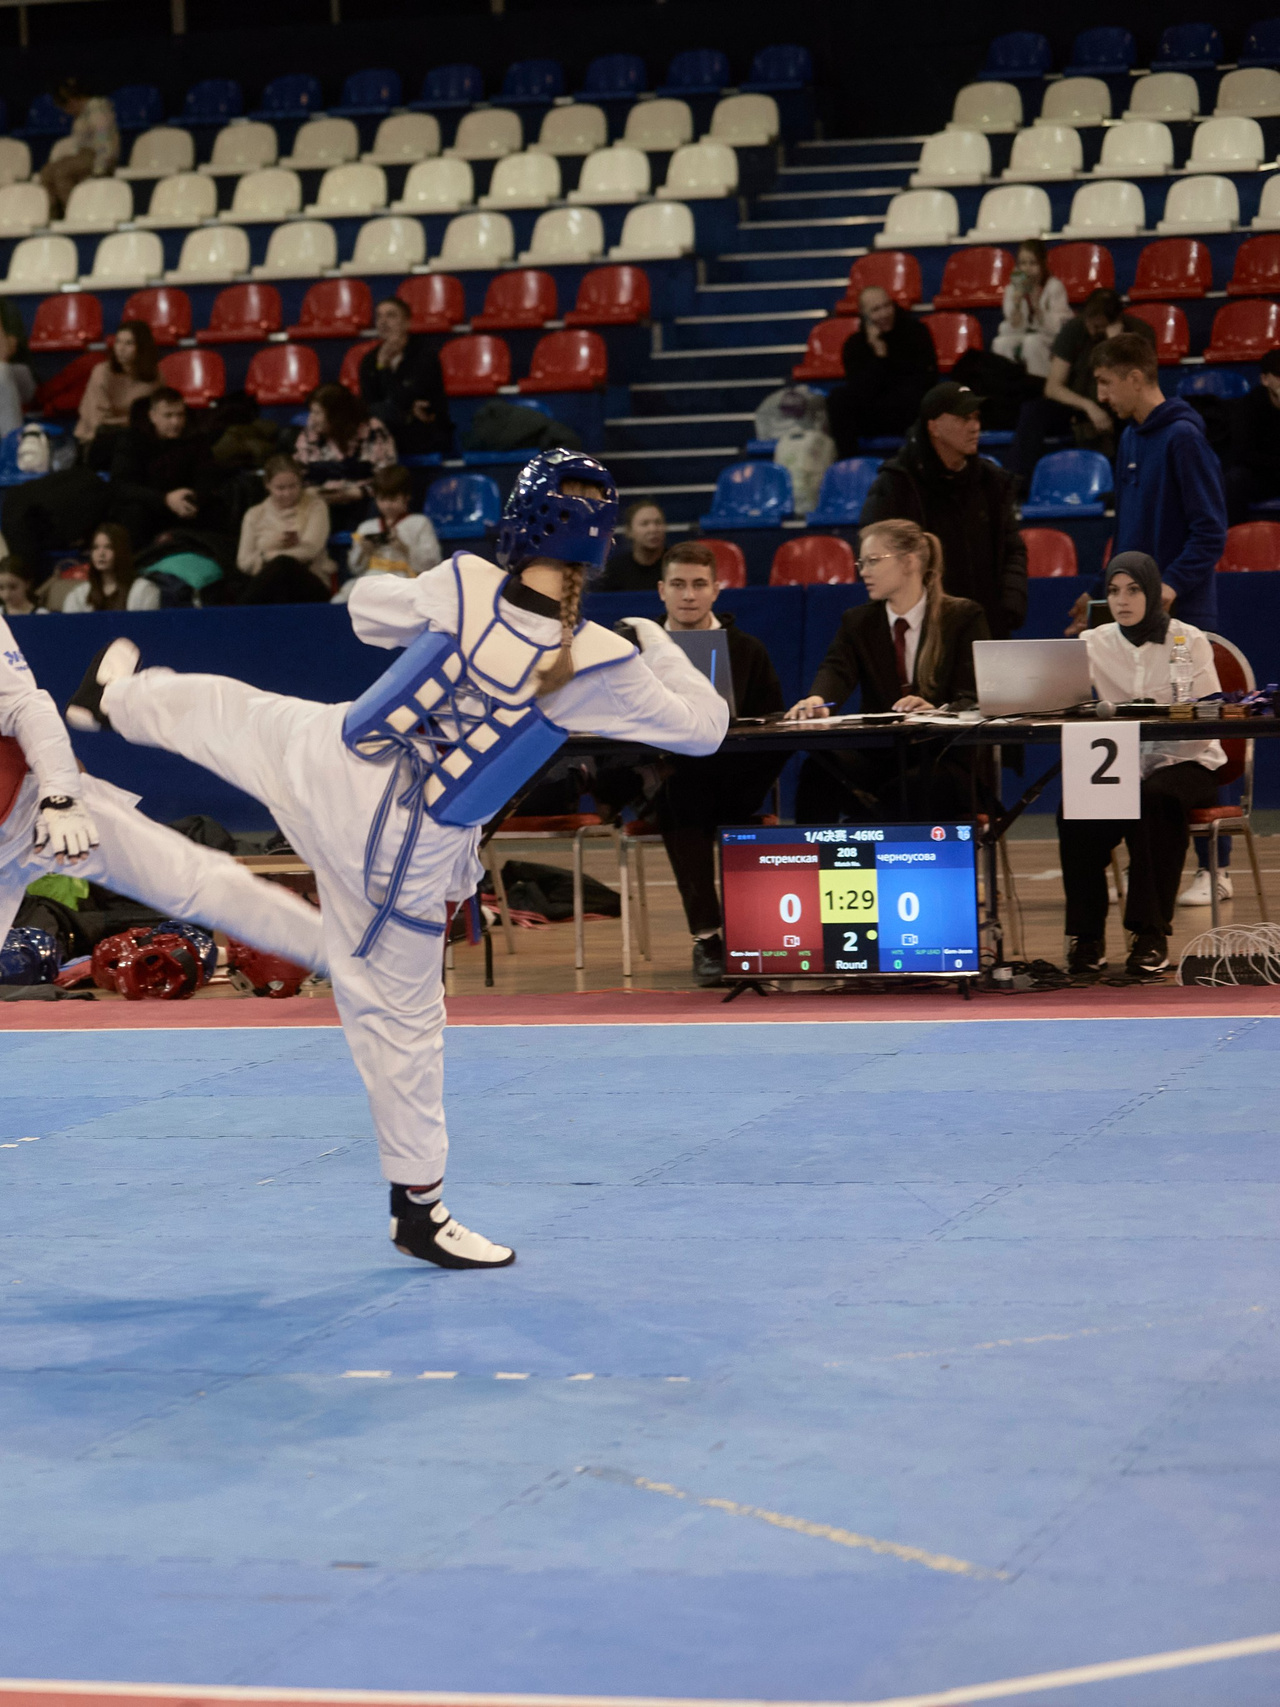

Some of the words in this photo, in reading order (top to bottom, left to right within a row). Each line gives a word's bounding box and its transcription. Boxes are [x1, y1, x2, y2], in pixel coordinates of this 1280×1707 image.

[1090, 738, 1120, 784] 2
[848, 830, 884, 841] -46KG
[759, 855, 818, 866] ястремская
[877, 853, 936, 864] черноусова
[825, 890, 874, 910] 1:29
[779, 893, 802, 924] 0
[897, 891, 920, 922] 0
[842, 931, 859, 952] 2
[741, 961, 750, 971] 0
[800, 960, 810, 971] 0
[835, 960, 868, 970] Round
[893, 959, 903, 970] 0
[954, 959, 963, 969] 0
